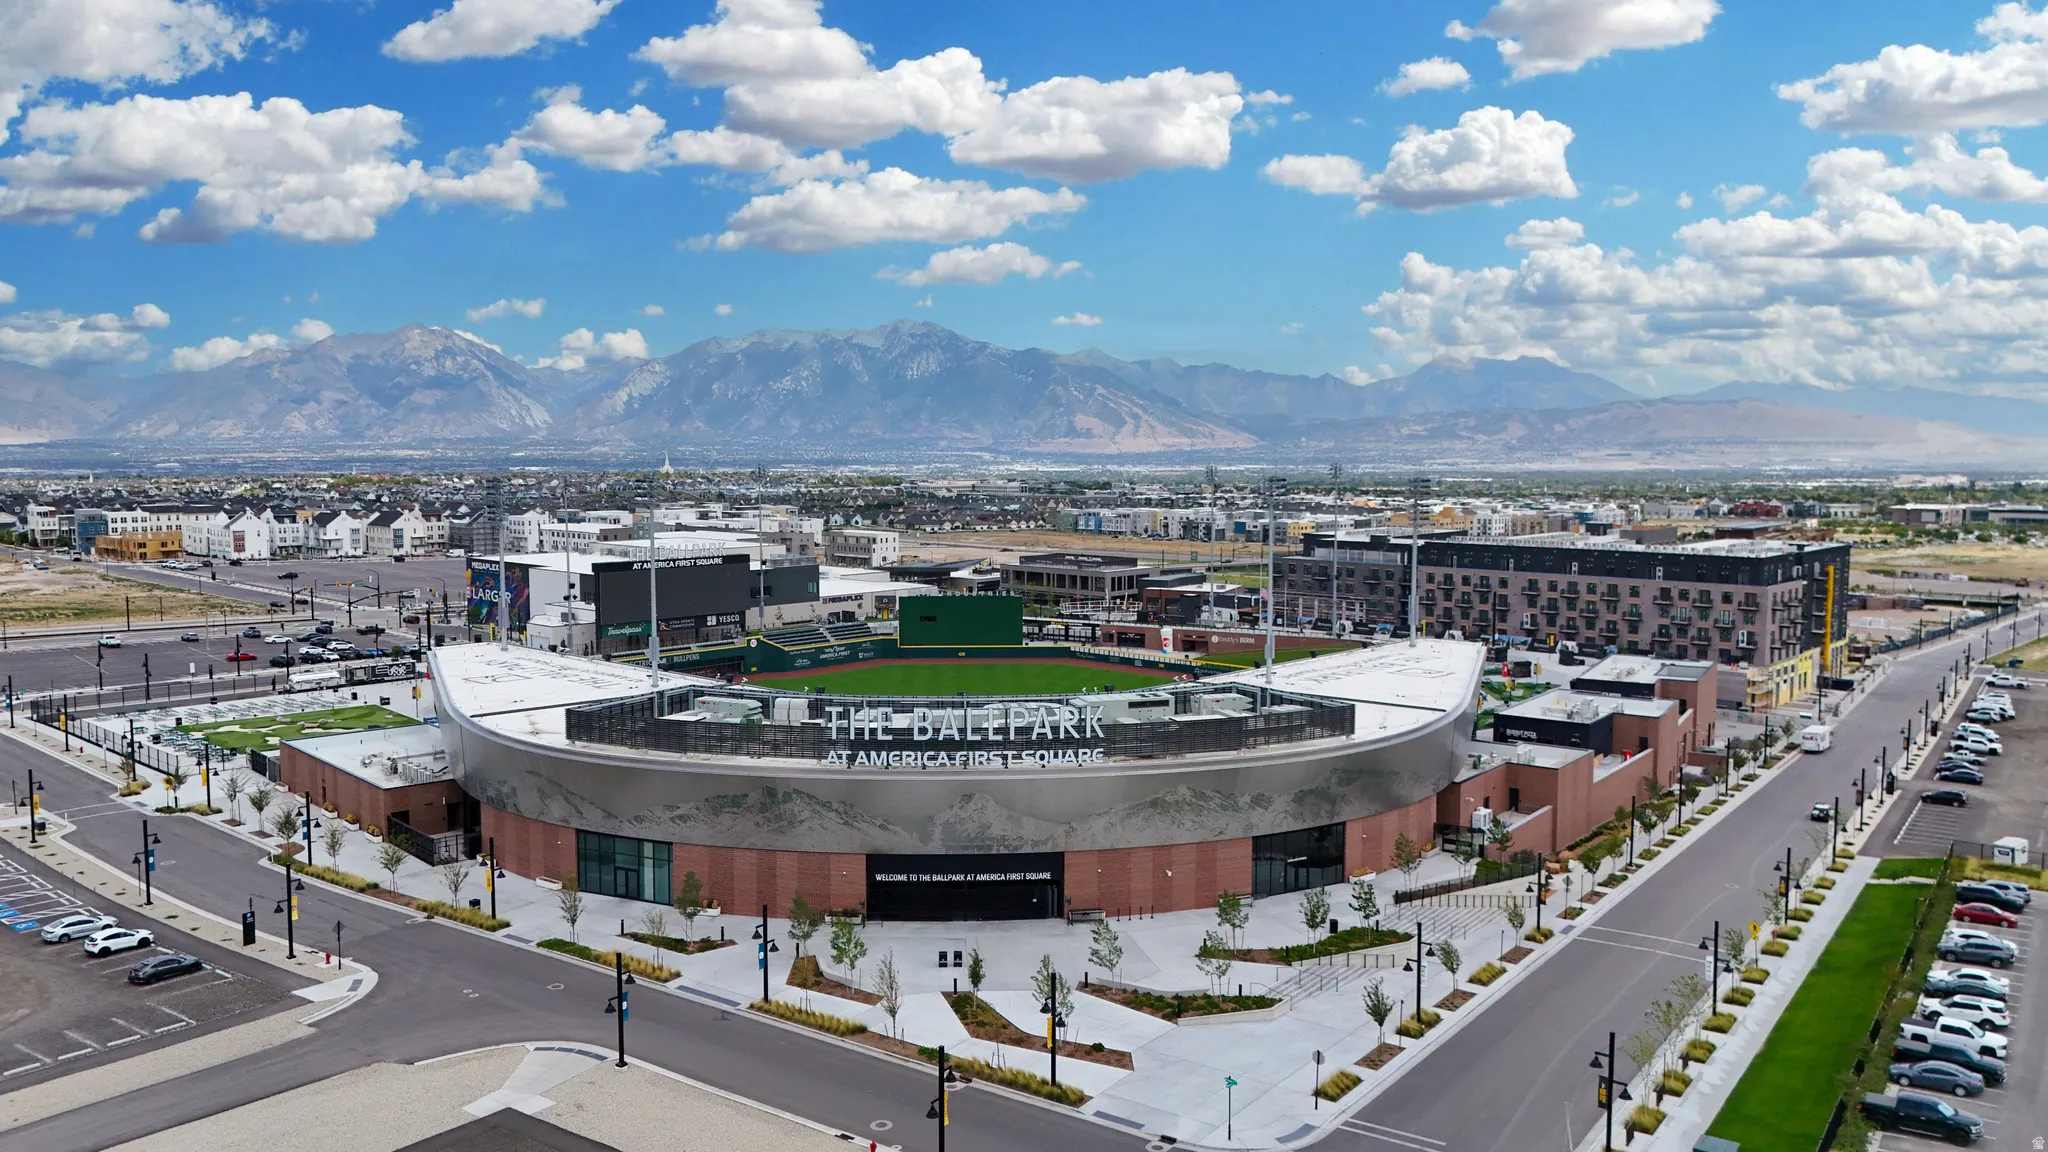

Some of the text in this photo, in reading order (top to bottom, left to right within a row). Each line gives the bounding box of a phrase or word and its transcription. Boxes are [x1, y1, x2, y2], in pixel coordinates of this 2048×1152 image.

[659, 541, 726, 561] BALLPARK
[632, 562, 642, 570] AT
[675, 559, 695, 567] FIRST
[696, 557, 723, 566] SQUARE
[472, 587, 512, 604] LARGR
[719, 614, 740, 623] YESCO
[607, 624, 642, 636] Travelpass
[1239, 636, 1255, 644] BERM
[673, 653, 700, 663] BULLPENS
[825, 705, 1105, 741] THE BALLPARK
[826, 748, 1104, 767] AT AMERICA FIRST SQUARE
[875, 871, 1052, 882] WELCOME TO THE BALLPARK AT AMERICA FIRST SQUARE
